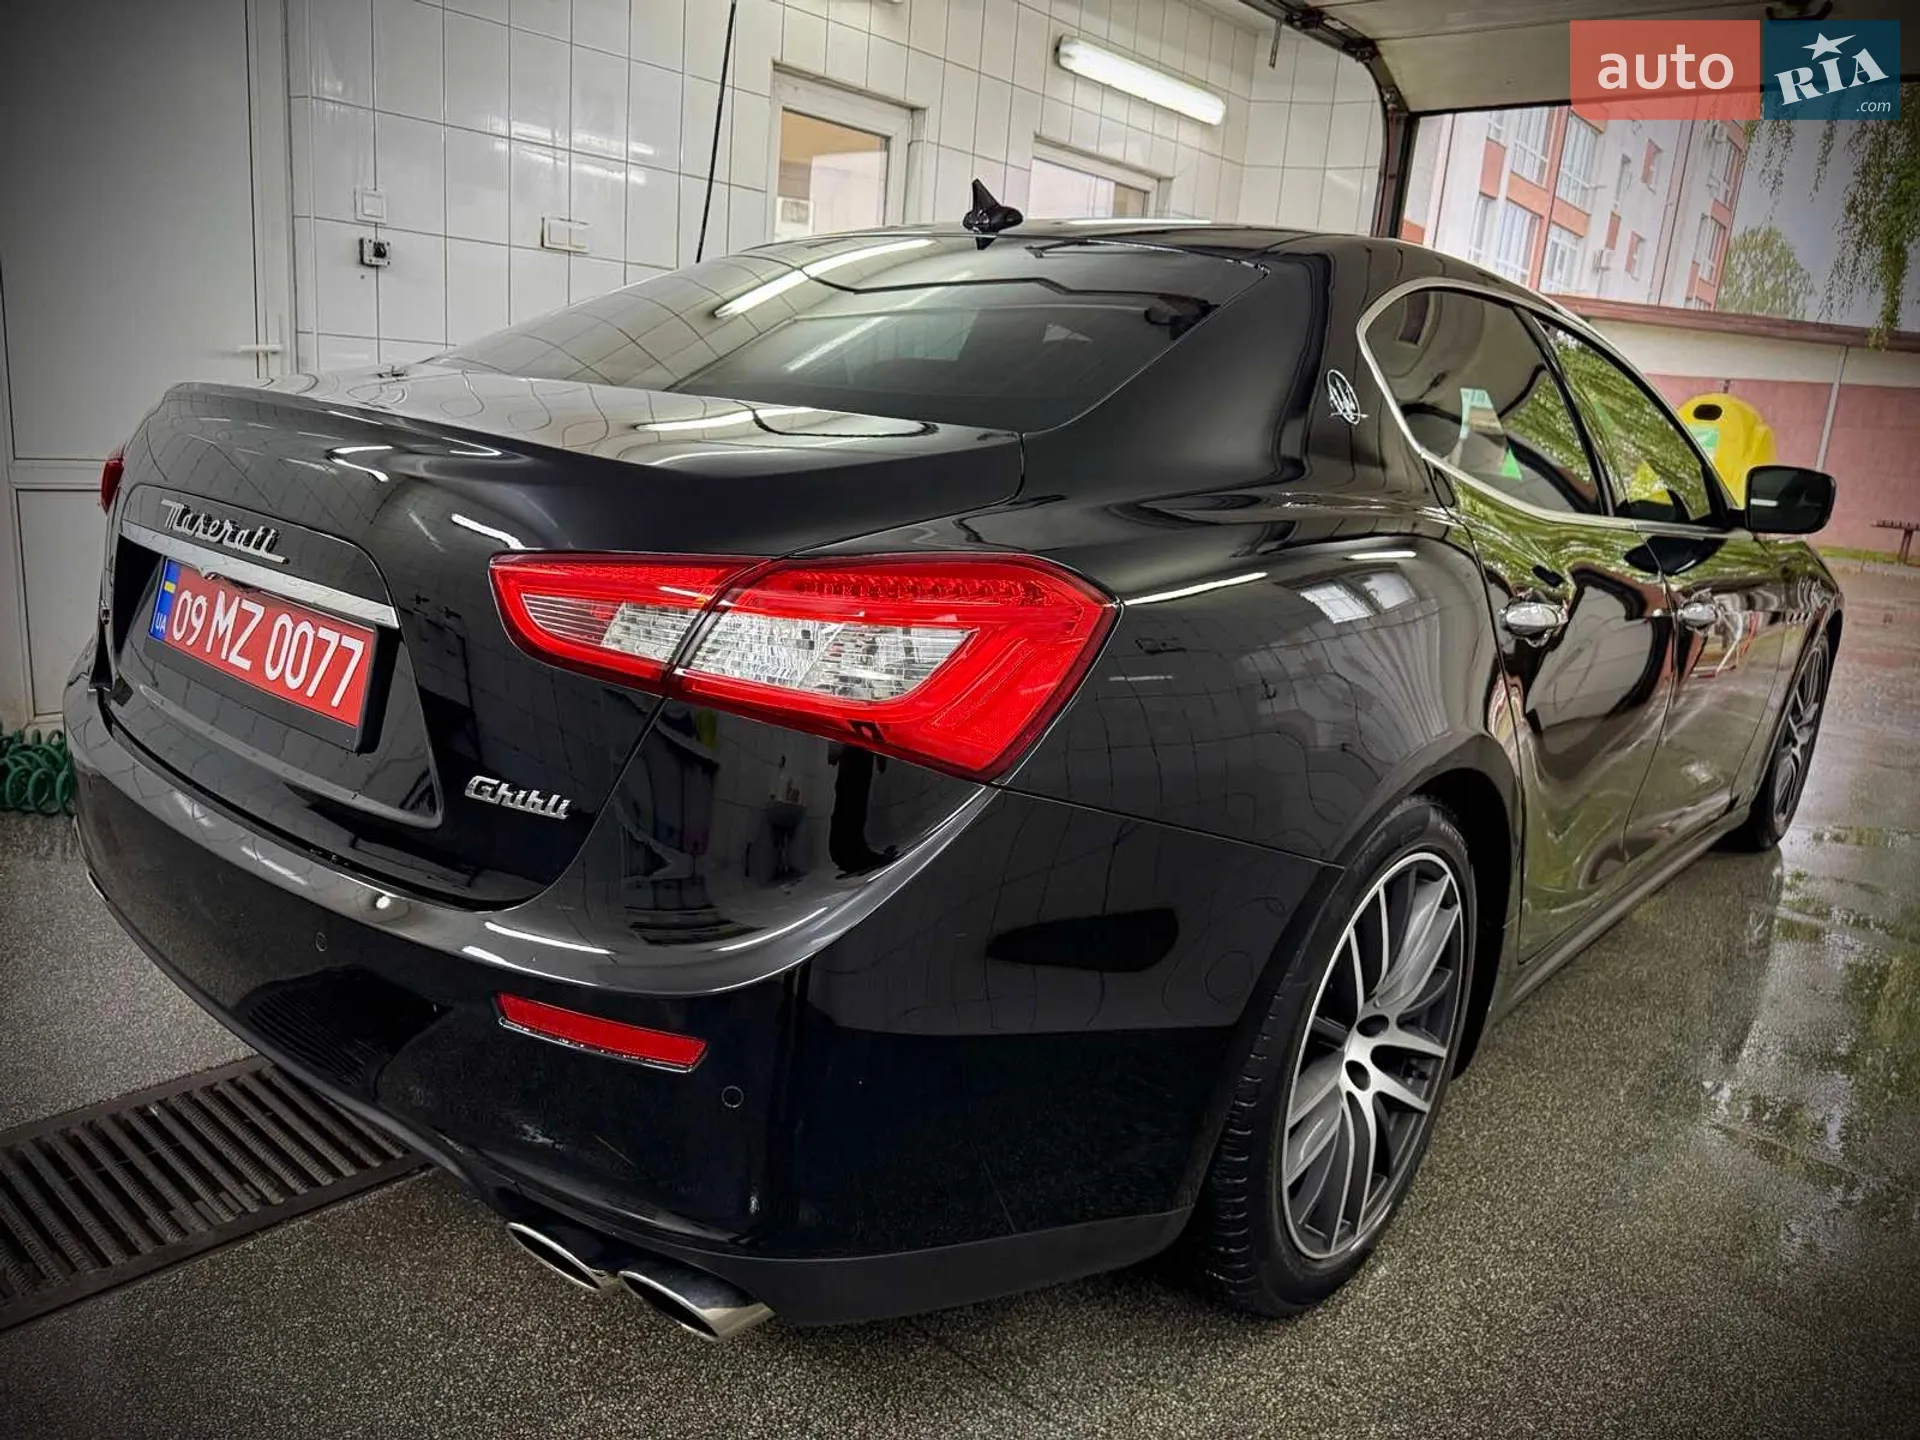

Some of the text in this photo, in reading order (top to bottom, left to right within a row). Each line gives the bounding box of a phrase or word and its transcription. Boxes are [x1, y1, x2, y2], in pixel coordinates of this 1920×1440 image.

[161, 499, 286, 563] Maserati
[155, 612, 167, 634] UA
[172, 589, 365, 708] 09 MZ 0077
[464, 775, 571, 820] Ghibli
